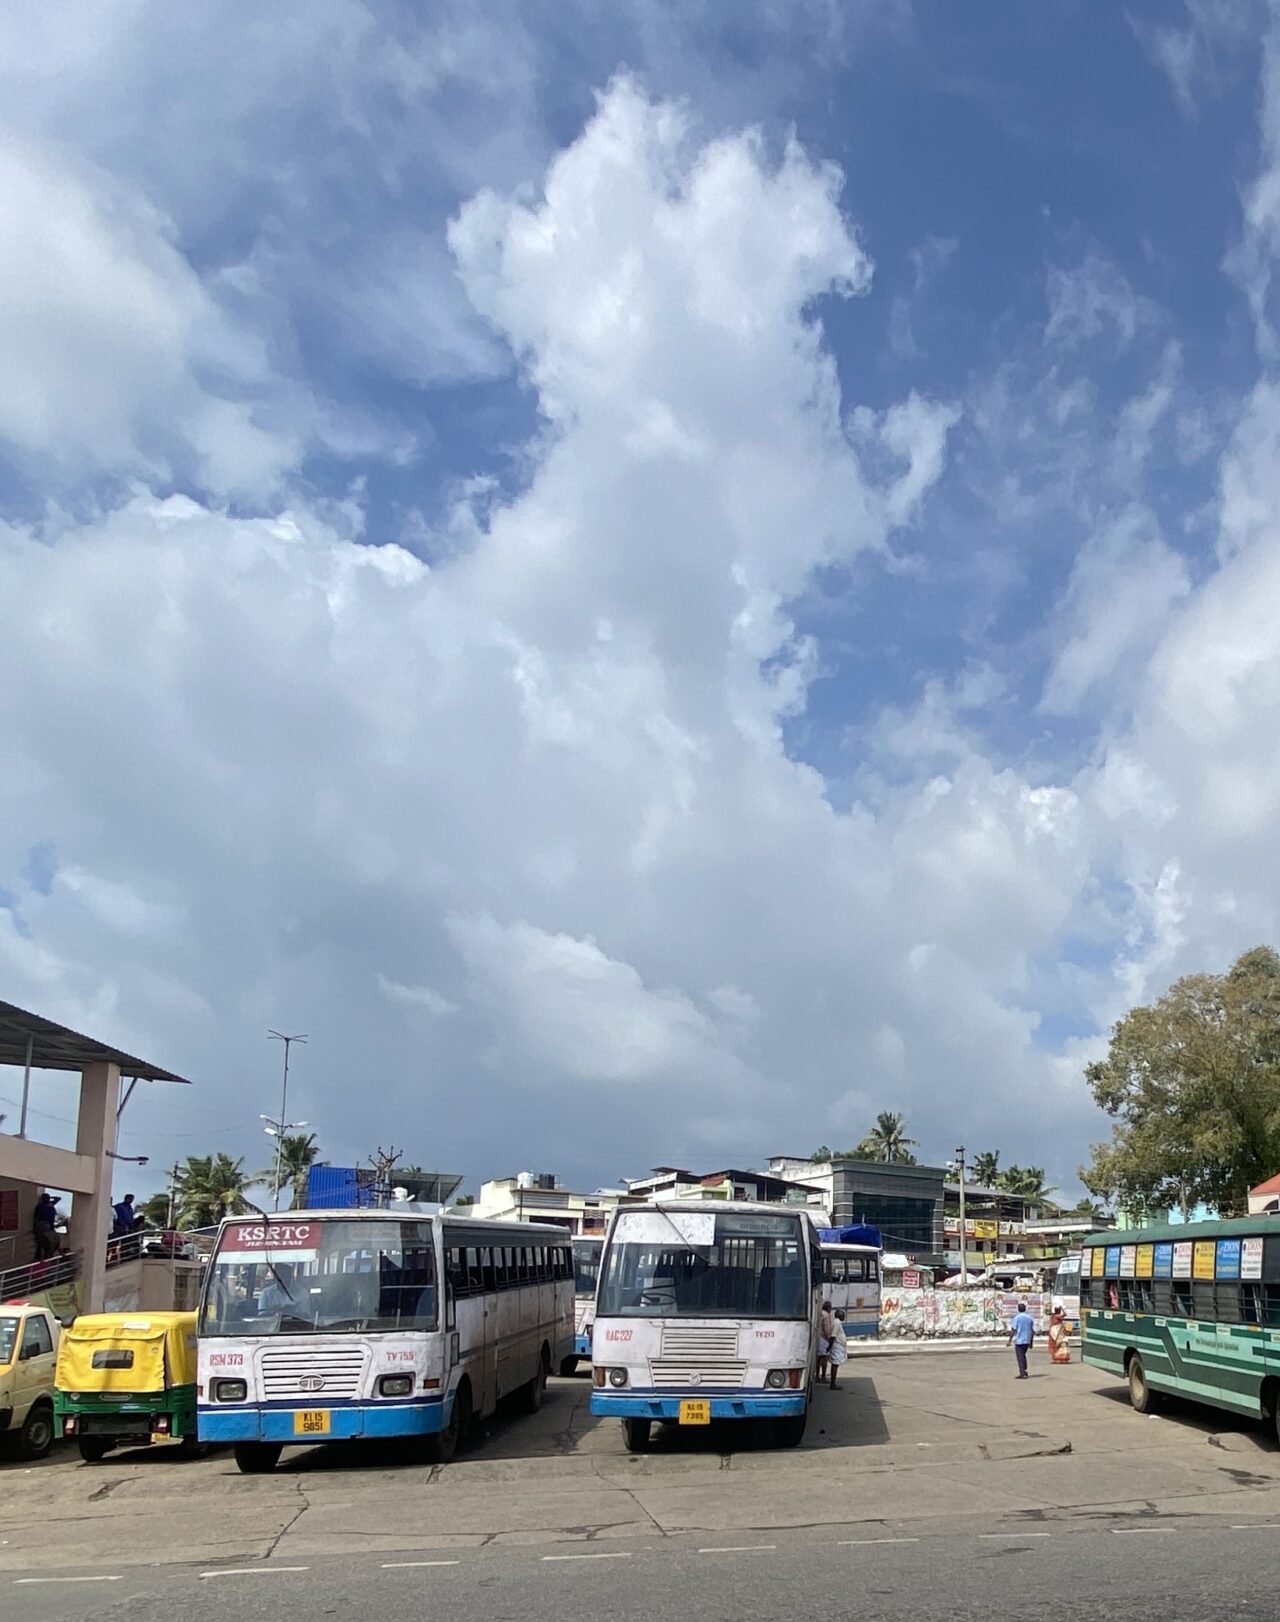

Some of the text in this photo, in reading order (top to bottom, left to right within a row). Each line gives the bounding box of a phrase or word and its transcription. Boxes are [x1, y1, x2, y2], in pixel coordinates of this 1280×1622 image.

[236, 1225, 310, 1241] KSRTC
[1222, 1240, 1241, 1253] ZION
[227, 1354, 243, 1366] 373
[386, 1352, 398, 1361] TV
[315, 1412, 324, 1422] 15
